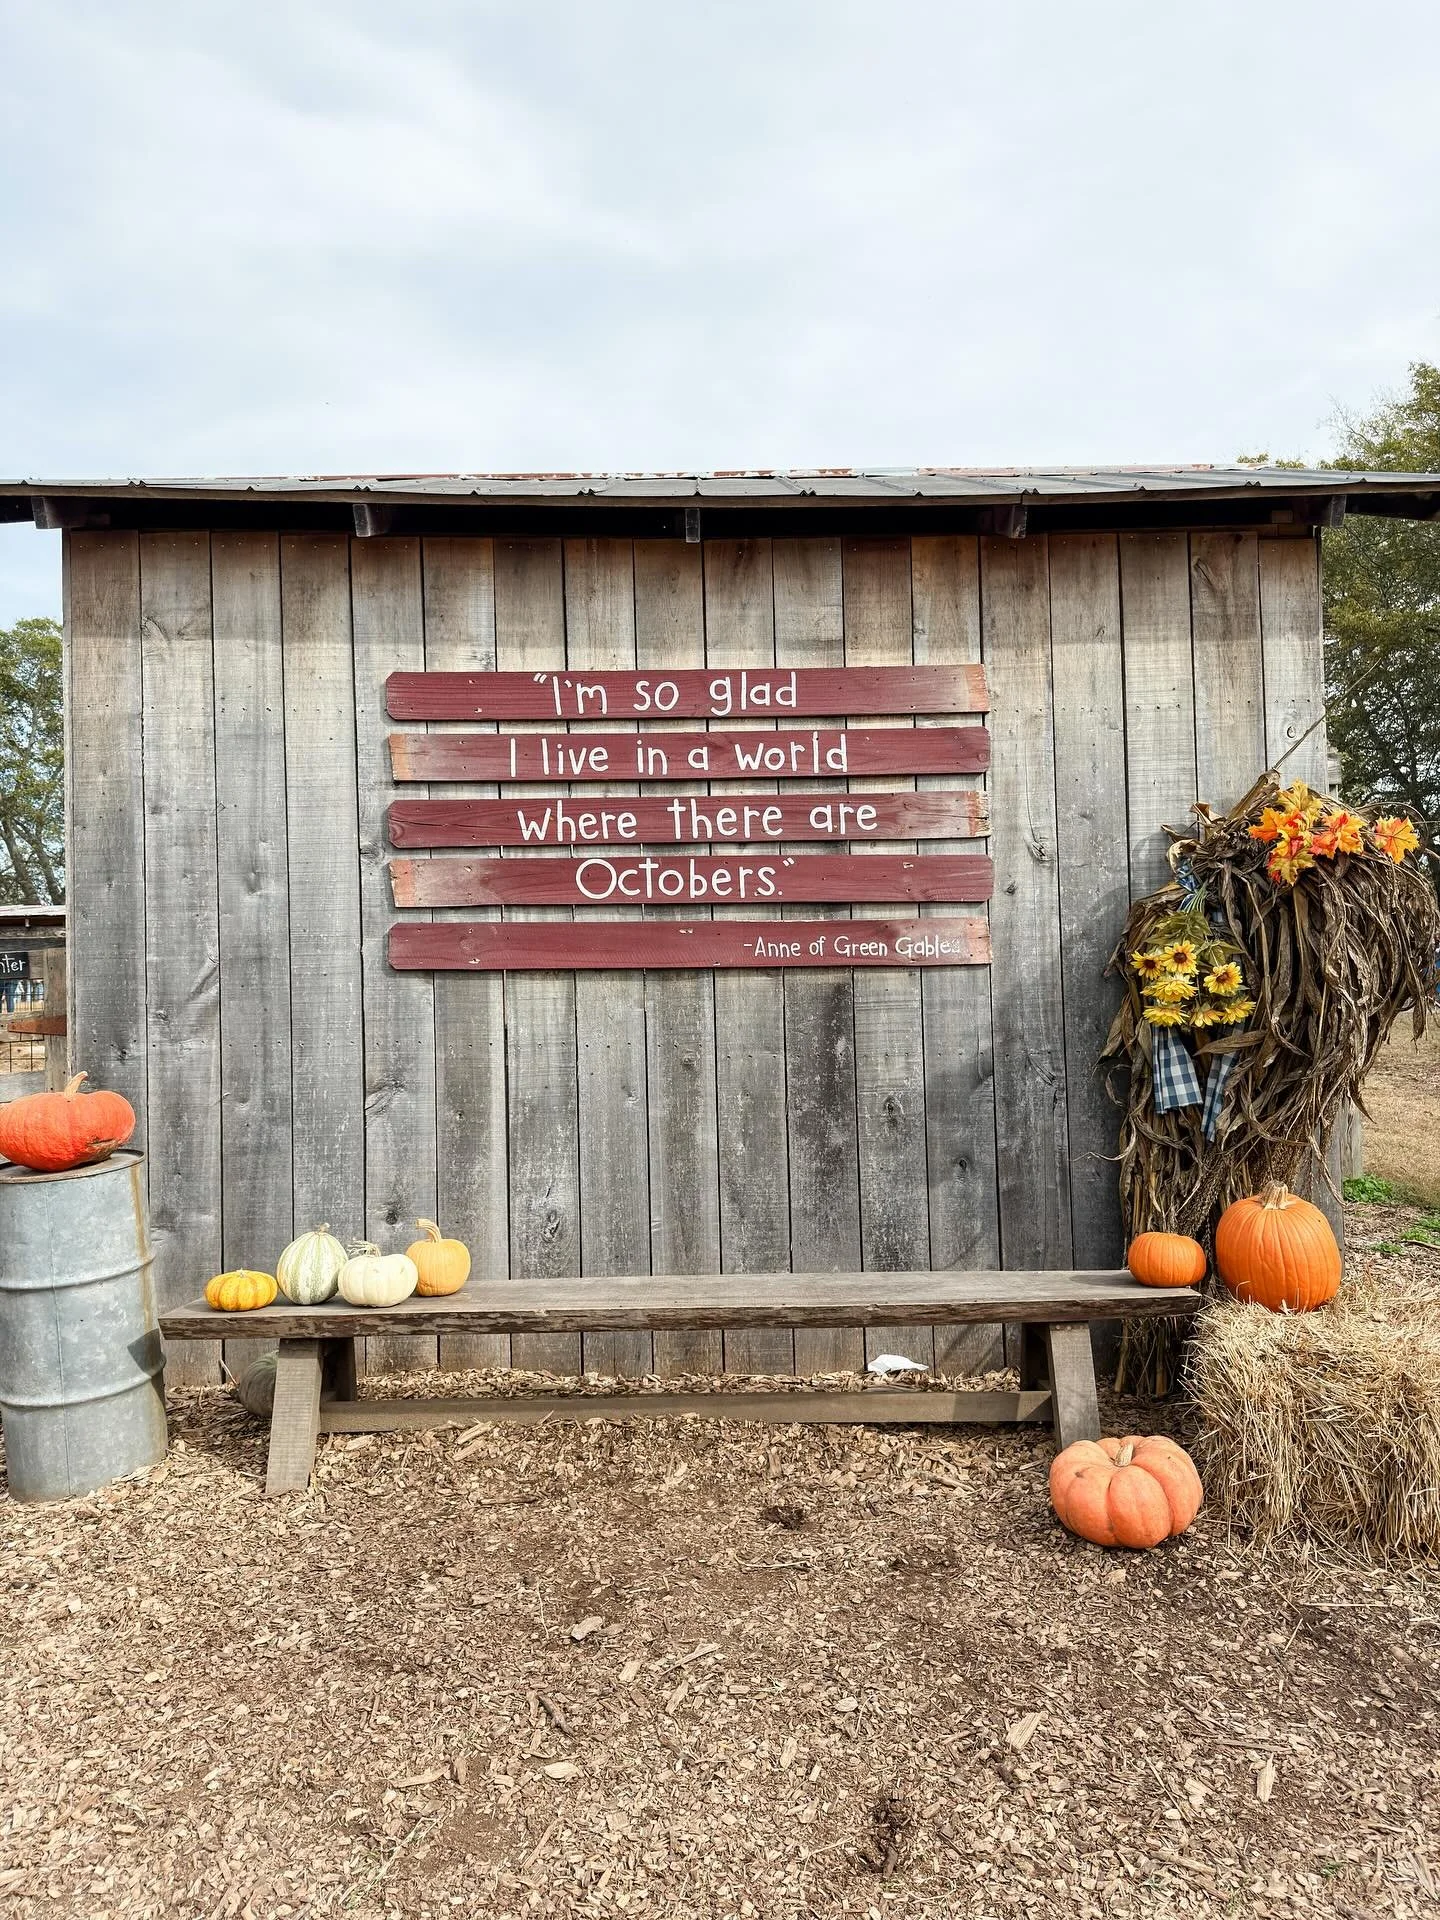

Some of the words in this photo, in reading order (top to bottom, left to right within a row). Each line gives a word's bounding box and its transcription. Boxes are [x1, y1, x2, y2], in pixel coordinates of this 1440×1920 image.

[633, 680, 680, 711] so
[709, 671, 797, 717] glad
[510, 738, 517, 777] I
[541, 739, 609, 775] live
[636, 740, 668, 776] in
[687, 746, 709, 771] a
[734, 731, 848, 773] world
[517, 799, 637, 842] where
[666, 798, 784, 840] there
[809, 803, 878, 835] are
[743, 936, 801, 958] -Anne
[809, 936, 826, 957] of
[833, 935, 888, 957] Green
